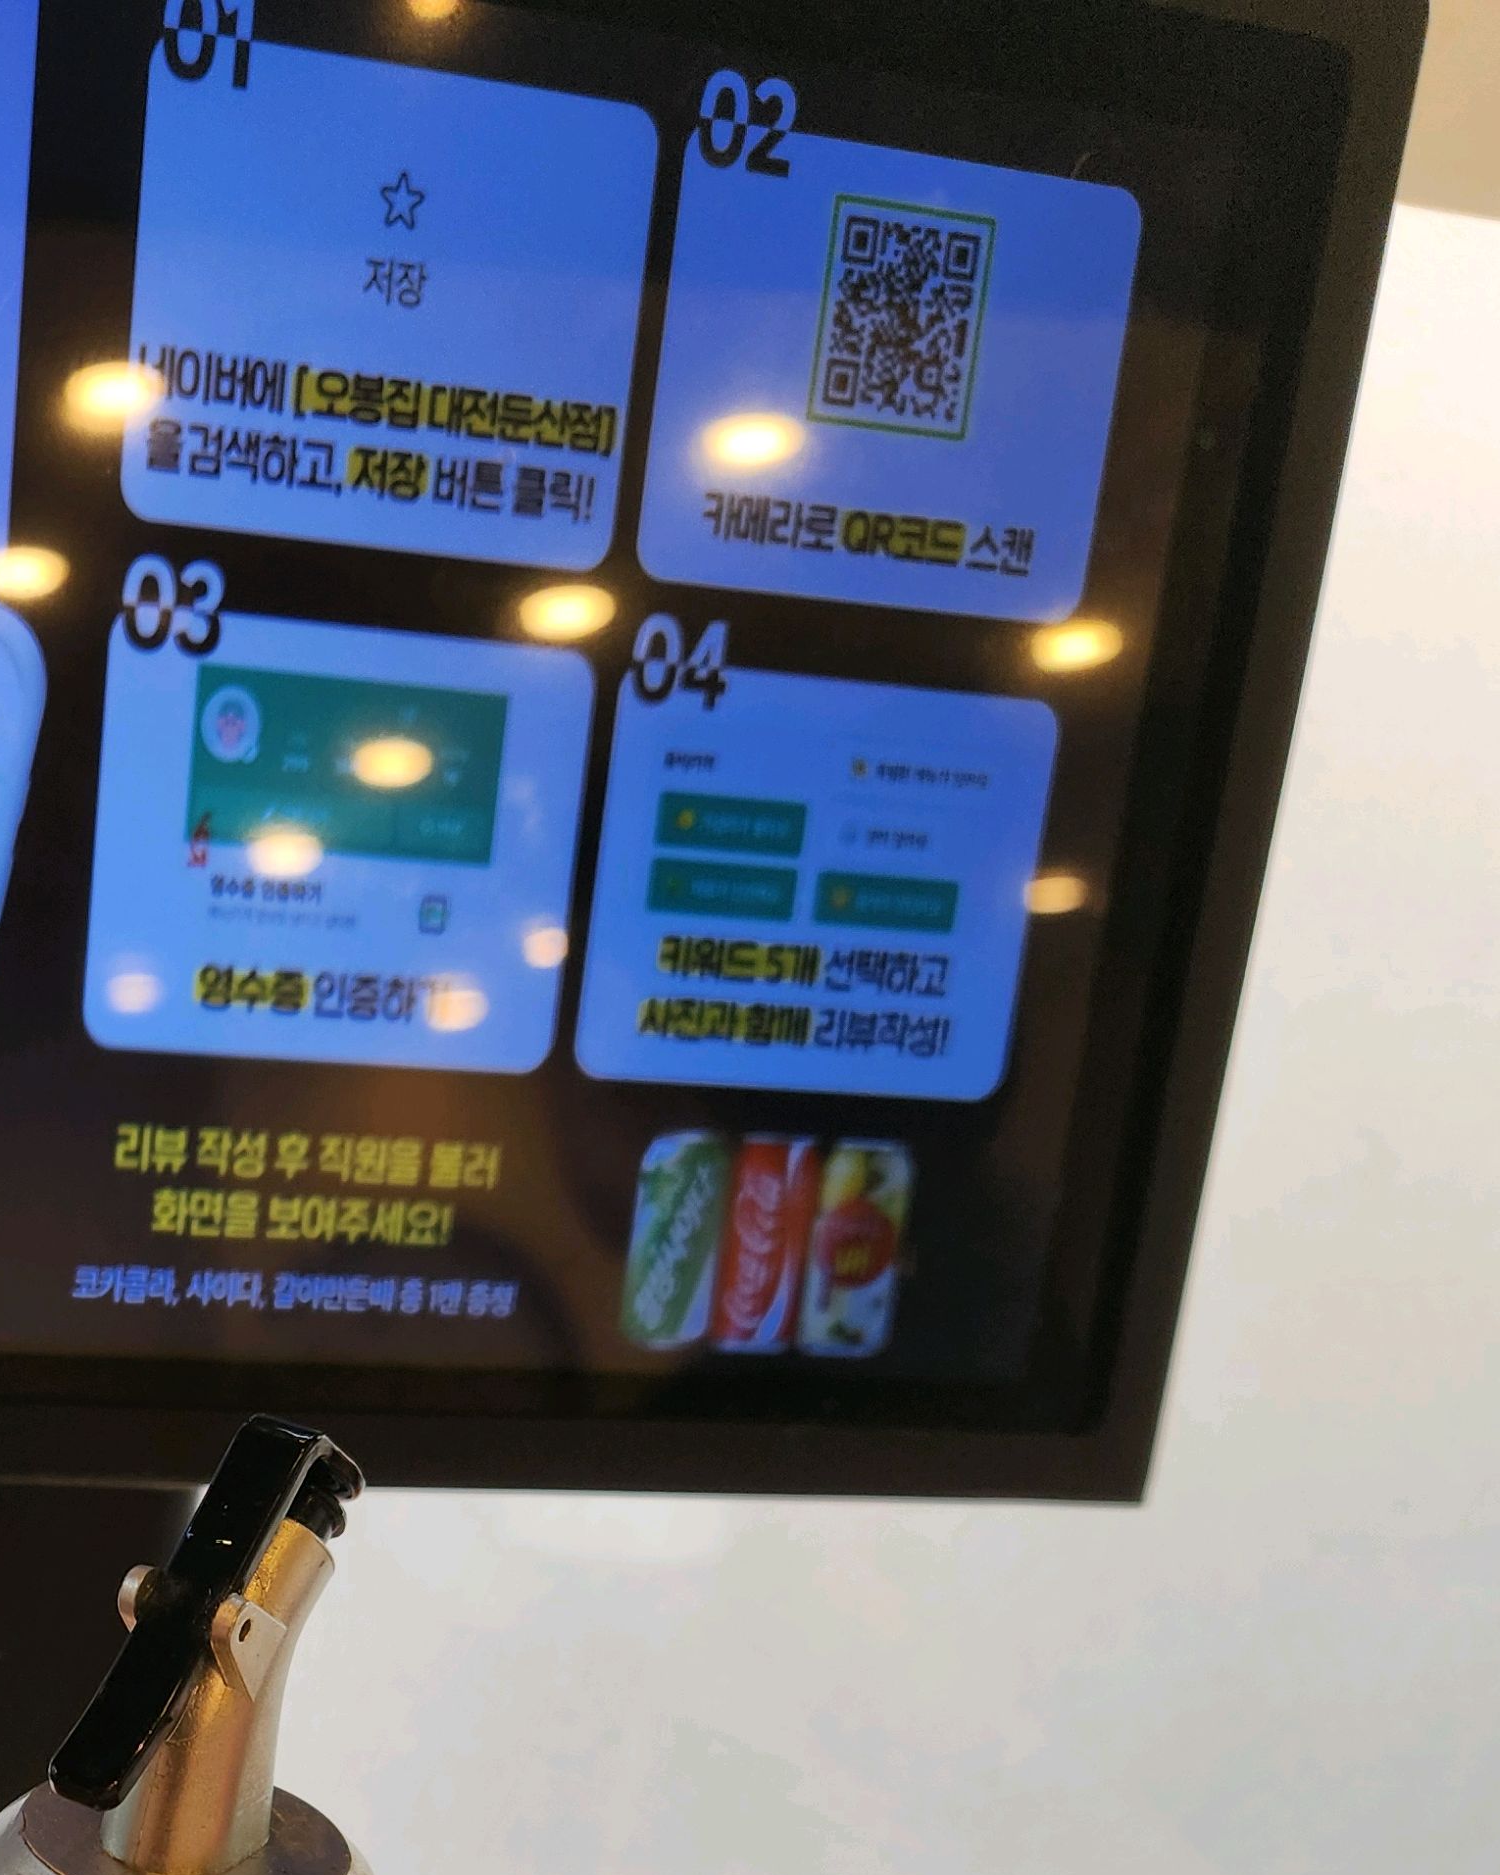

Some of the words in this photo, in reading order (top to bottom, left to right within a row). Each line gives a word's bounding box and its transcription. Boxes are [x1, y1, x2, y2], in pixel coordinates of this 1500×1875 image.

[163, 0, 256, 90] 01
[699, 69, 798, 179] 02
[362, 257, 429, 309] 저장
[352, 446, 427, 502] 저장
[435, 455, 505, 513] 버튼
[511, 466, 597, 523] 클릭!
[702, 492, 839, 552] 카메라로
[844, 509, 965, 568] QR코드
[965, 525, 1036, 578] 스캔
[121, 553, 226, 657] 03
[632, 612, 730, 712] 04
[199, 962, 302, 1013] 영수증
[824, 946, 950, 998] 선택하고
[113, 1121, 190, 1175] 리뷰
[196, 1125, 269, 1180] 작성
[274, 1131, 311, 1181] 후
[318, 1133, 424, 1187] 직원을
[428, 1139, 500, 1191] 불러
[150, 1184, 261, 1240] 화면을
[265, 1193, 455, 1247] 보여주세요!
